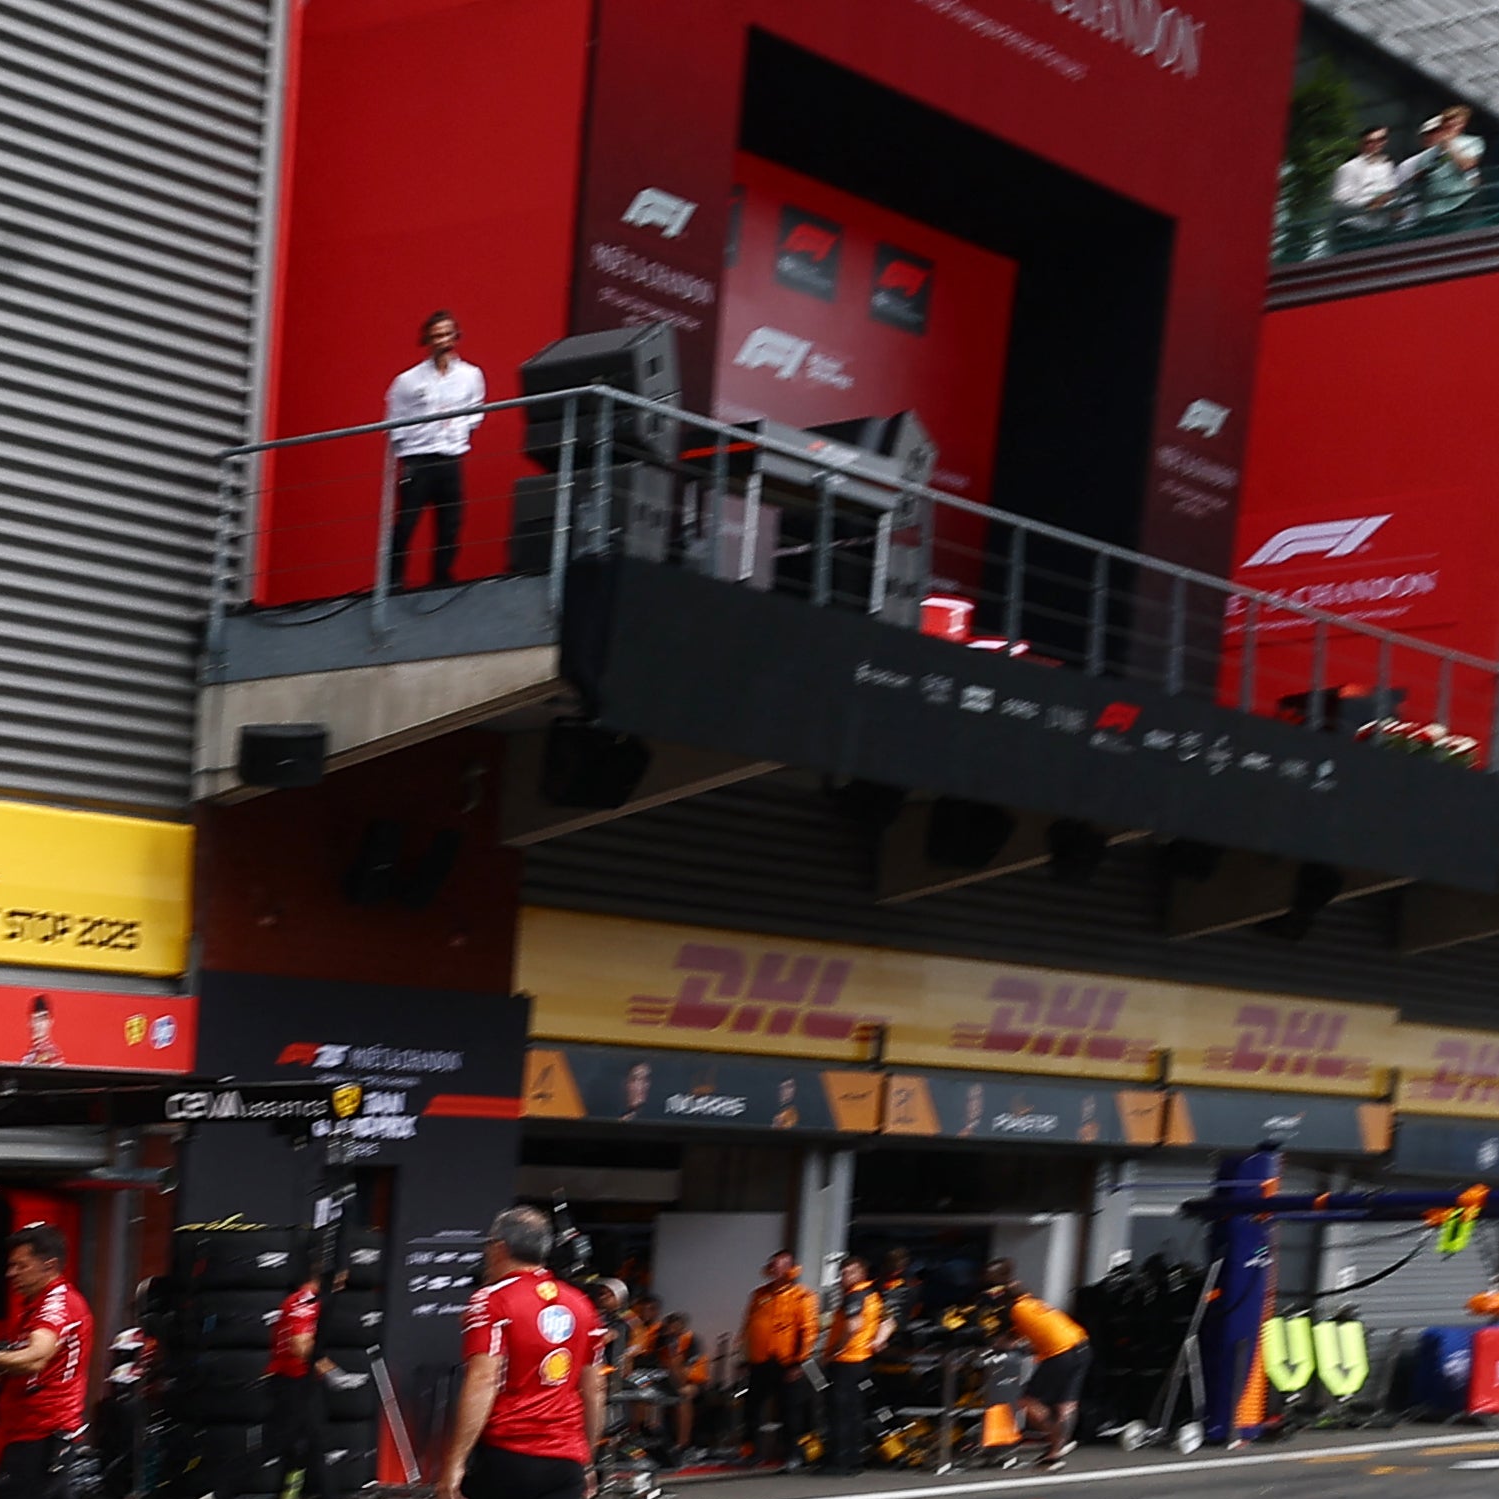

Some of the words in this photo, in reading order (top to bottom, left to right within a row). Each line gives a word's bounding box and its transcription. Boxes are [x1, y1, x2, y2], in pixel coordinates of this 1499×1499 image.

[1240, 513, 1394, 569] F1
[3, 909, 72, 945] STOP
[74, 914, 142, 952] 2025
[667, 943, 855, 1040] DHL
[982, 976, 1128, 1060] DHL
[1231, 1004, 1347, 1077] DHL
[1431, 1039, 1499, 1102] DH
